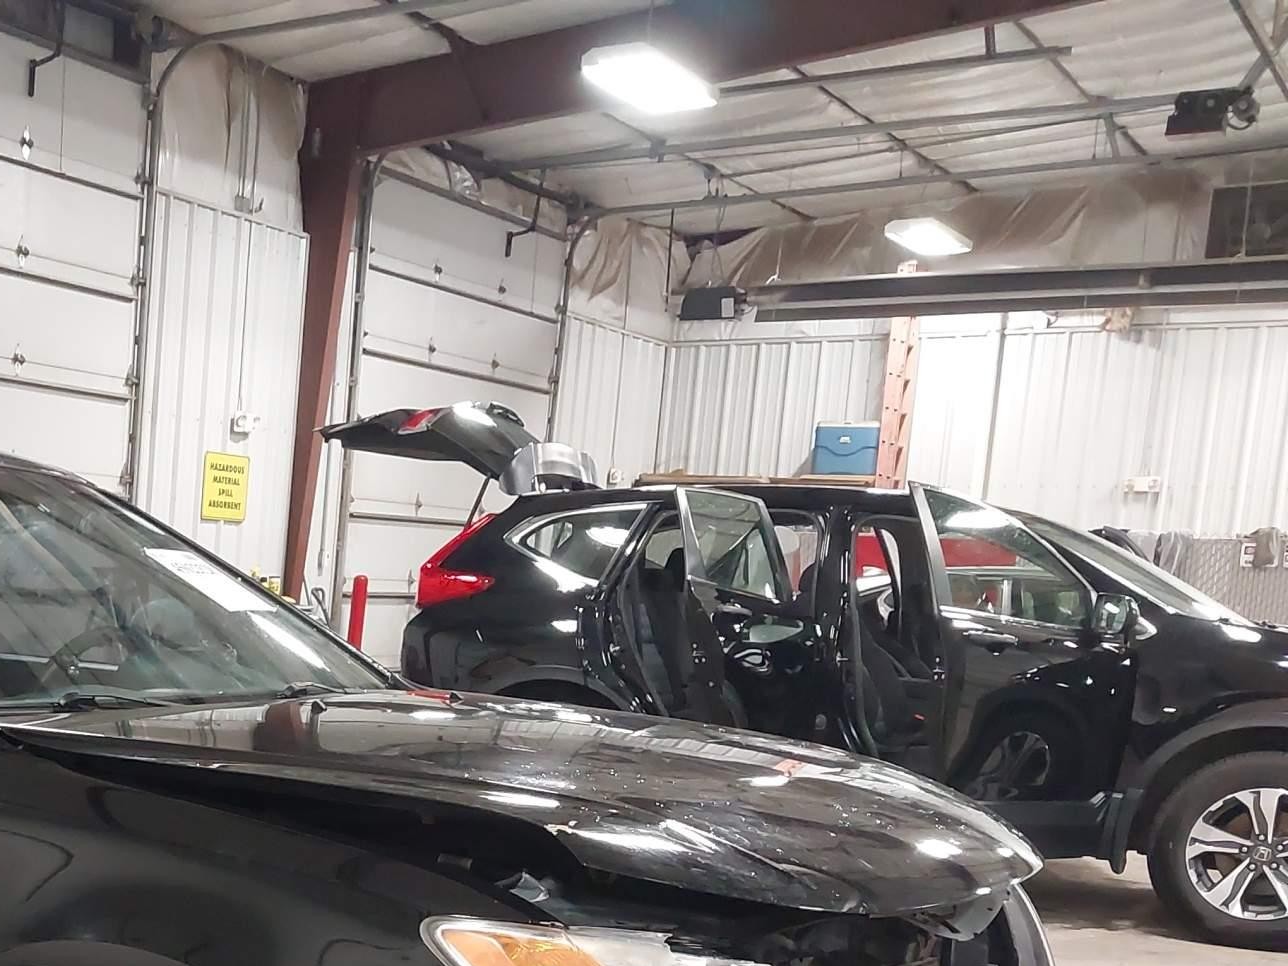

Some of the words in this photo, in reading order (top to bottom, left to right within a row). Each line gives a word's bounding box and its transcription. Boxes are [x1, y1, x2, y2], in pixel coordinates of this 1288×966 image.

[210, 462, 245, 475] HAZARDOUS
[213, 474, 240, 486] MATERIAL
[218, 487, 233, 498] SPILL
[208, 499, 241, 511] ABSORBENT
